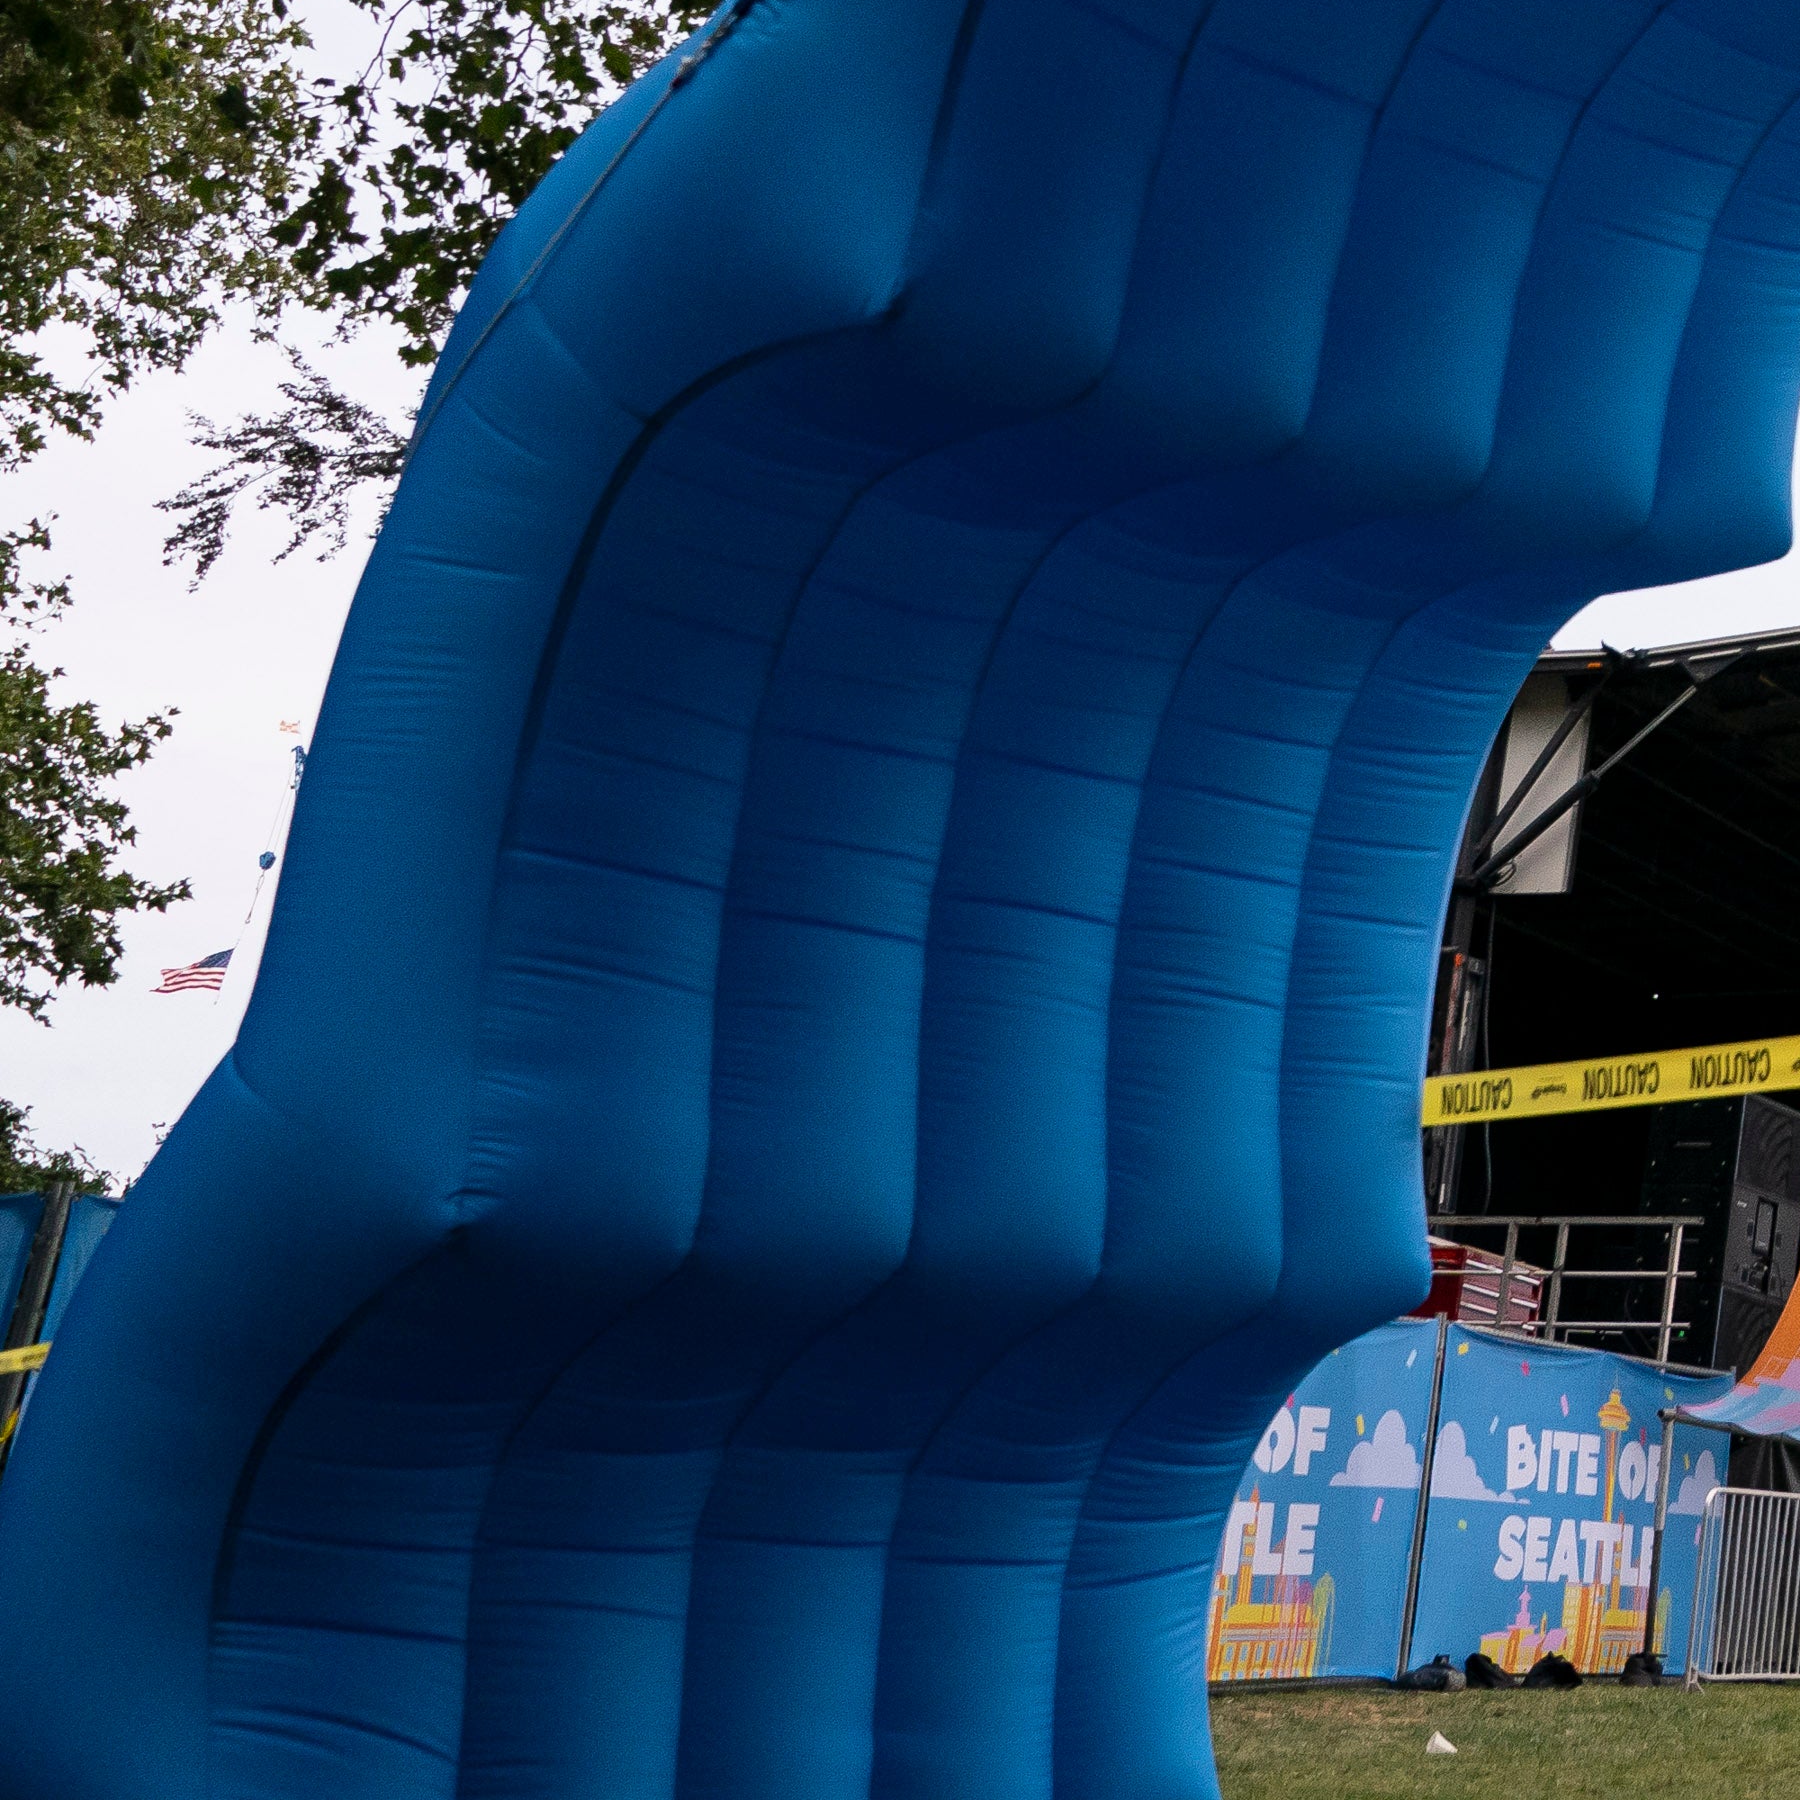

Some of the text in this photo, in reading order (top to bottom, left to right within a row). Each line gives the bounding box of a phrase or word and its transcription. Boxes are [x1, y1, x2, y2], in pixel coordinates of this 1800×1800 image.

[1582, 1060, 1660, 1100] CAUTION
[1688, 1048, 1771, 1089] CAUTION
[1441, 1077, 1512, 1115] CAUTION
[1254, 1406, 1331, 1475] OF
[1507, 1425, 1600, 1496] BITE
